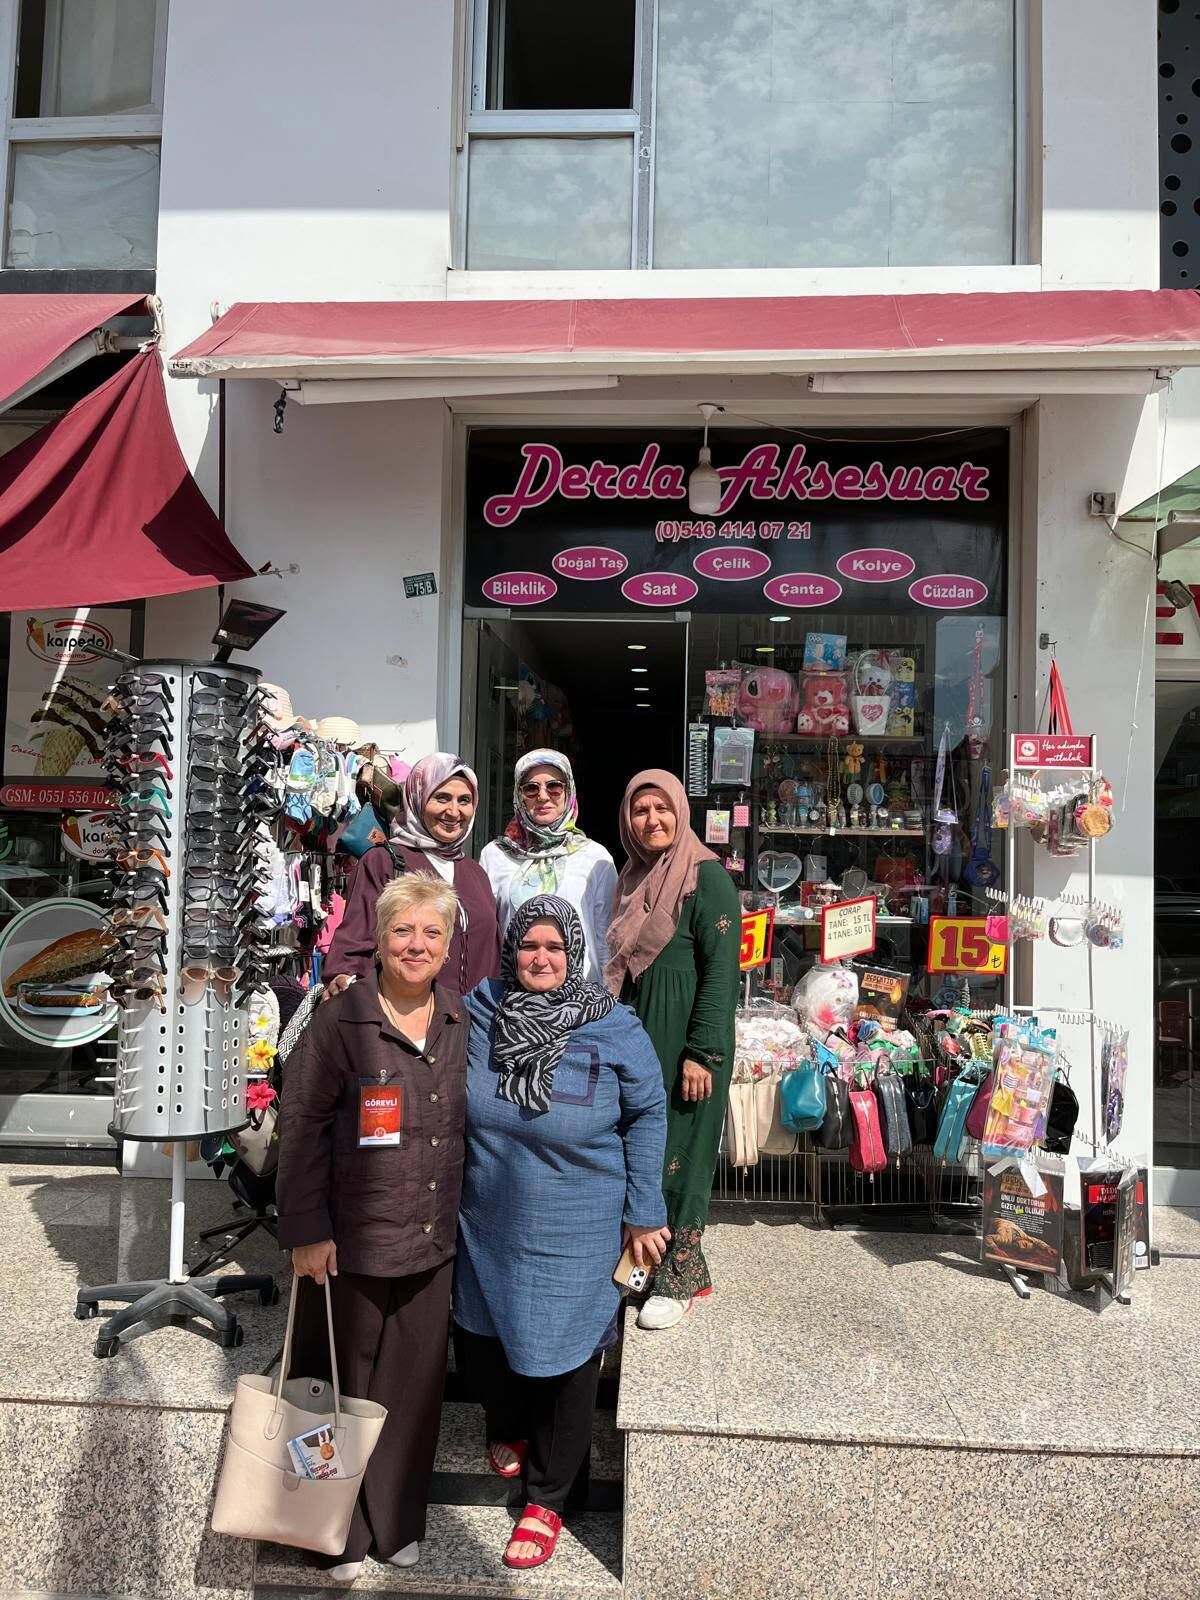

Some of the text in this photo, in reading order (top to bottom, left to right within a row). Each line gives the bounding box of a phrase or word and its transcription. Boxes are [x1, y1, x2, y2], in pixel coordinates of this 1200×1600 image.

[483, 443, 990, 527] Derda Aksesuar
[655, 520, 811, 542] (0)546 414 07 21
[558, 557, 624, 571] Doğal Taş
[712, 556, 751, 571] Çelik
[852, 558, 902, 573] Kolye
[491, 581, 546, 595] Bileklik
[641, 581, 677, 596] Saat
[779, 582, 824, 597] Çanta
[922, 584, 974, 599] Cüzdan
[5, 788, 36, 802] GSM:
[38, 790, 64, 803] 0551
[68, 791, 89, 804] 556
[863, 913, 871, 922] TL
[854, 925, 863, 935] 50
[863, 924, 872, 933] TL
[938, 925, 989, 967] 15
[364, 1097, 398, 1107] GÖREVLİ
